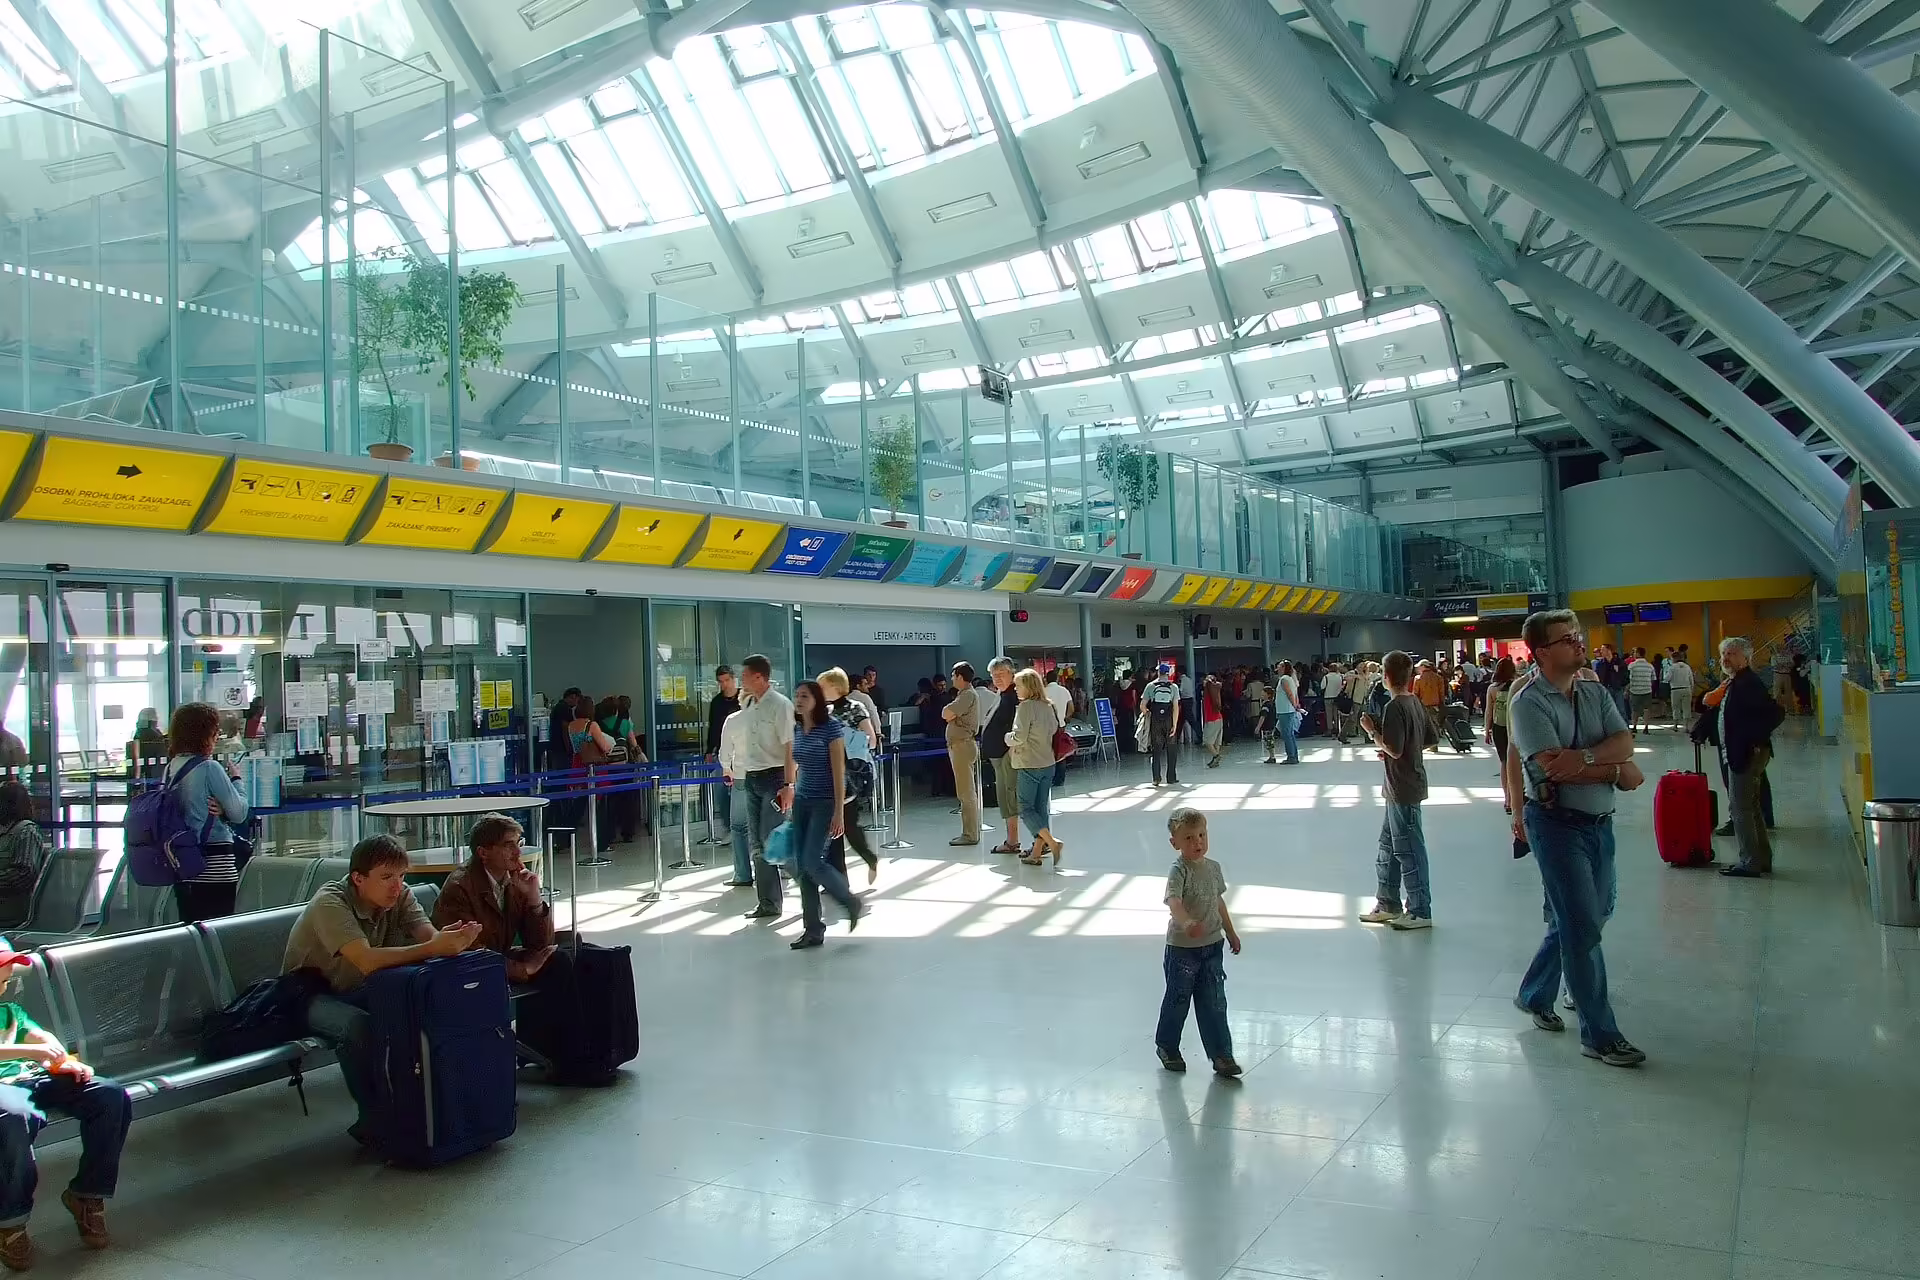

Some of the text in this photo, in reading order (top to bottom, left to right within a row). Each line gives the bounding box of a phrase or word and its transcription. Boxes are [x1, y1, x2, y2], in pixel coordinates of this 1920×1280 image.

[34, 486, 193, 507] OSOBNÍ PROHLÍDKA ZAVAZADEL
[62, 497, 160, 512] BAGGAGE CONTROL
[1434, 601, 1470, 612] Inflight
[874, 631, 900, 641] LETENKY
[904, 631, 913, 641] AIR
[914, 632, 937, 641] TICKETS
